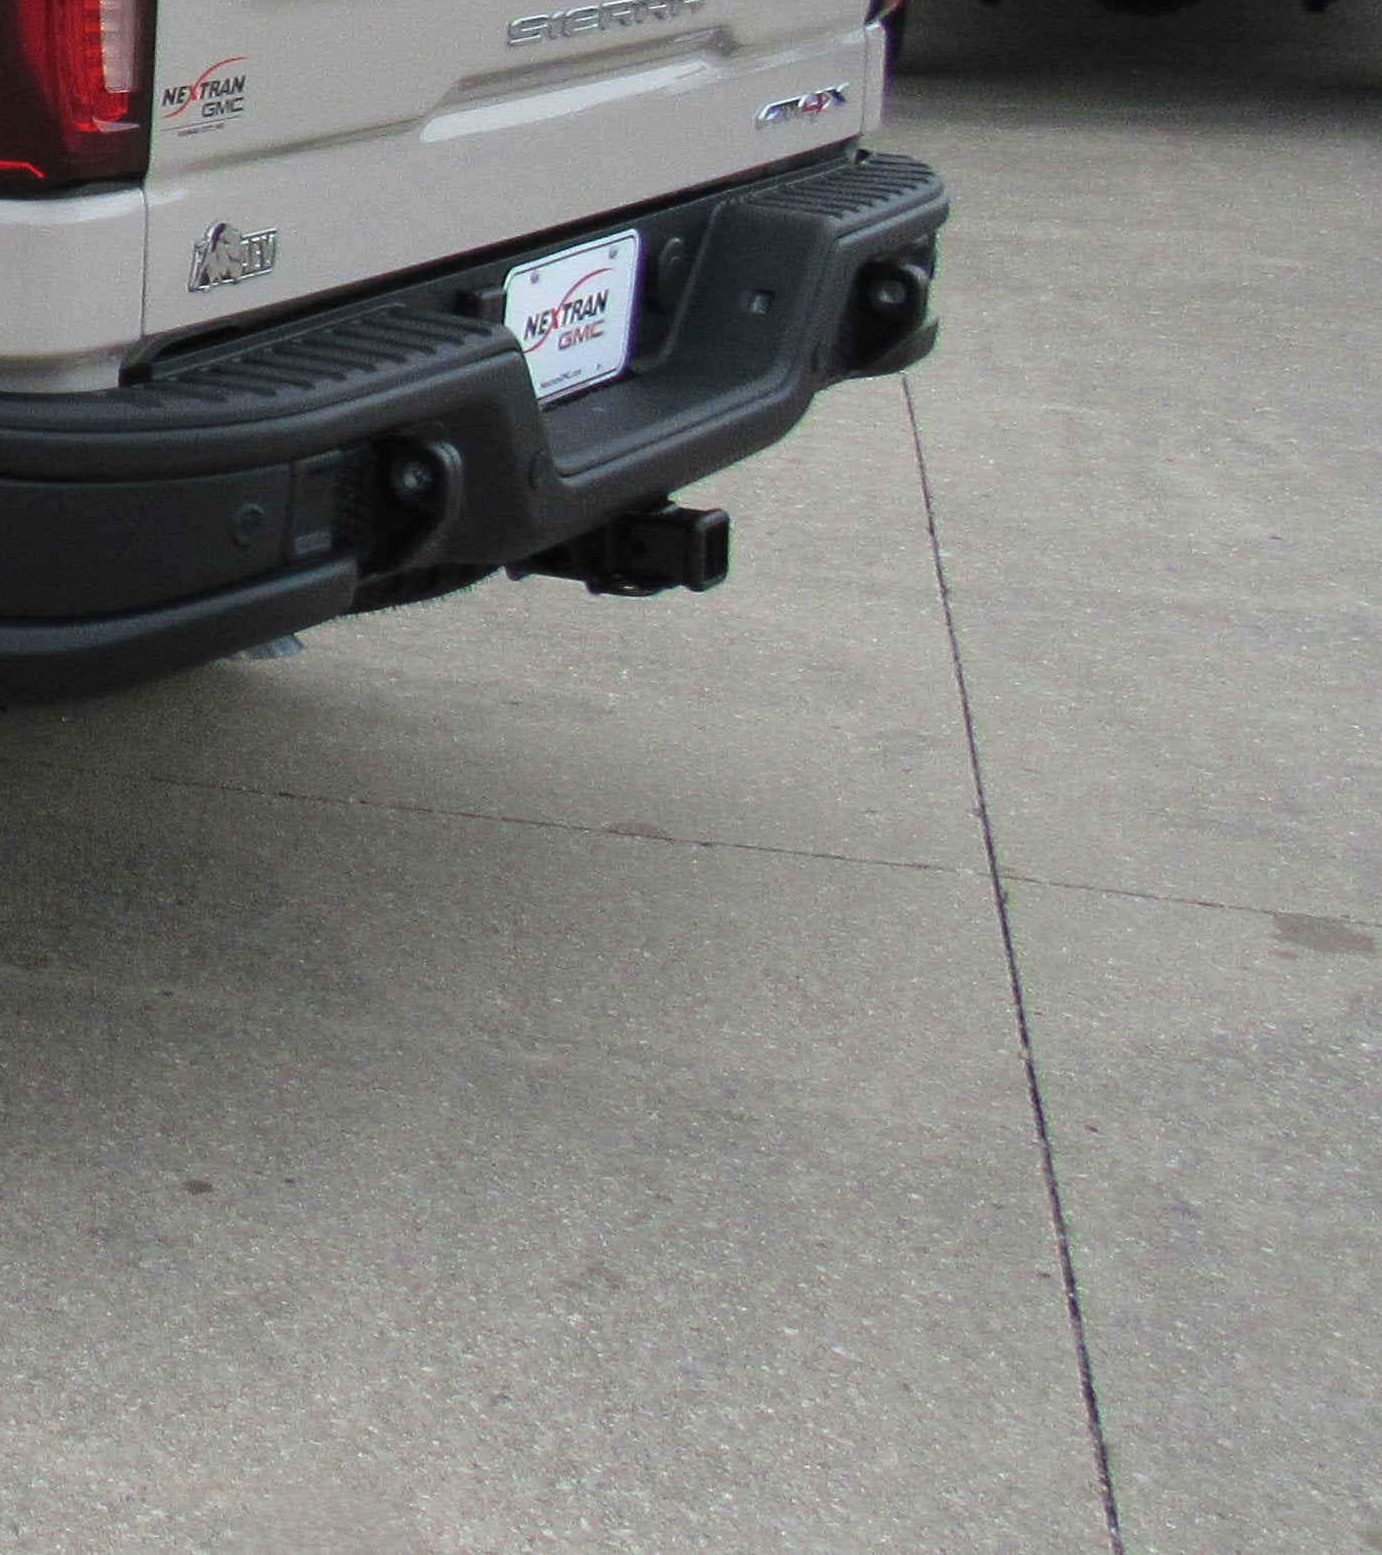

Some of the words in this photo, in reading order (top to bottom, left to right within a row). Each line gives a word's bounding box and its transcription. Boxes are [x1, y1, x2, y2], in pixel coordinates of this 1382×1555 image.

[161, 74, 247, 108] NEXTRAN
[201, 96, 245, 118] GMC
[522, 288, 610, 342] NEXTRAN
[557, 320, 605, 351] GMC
